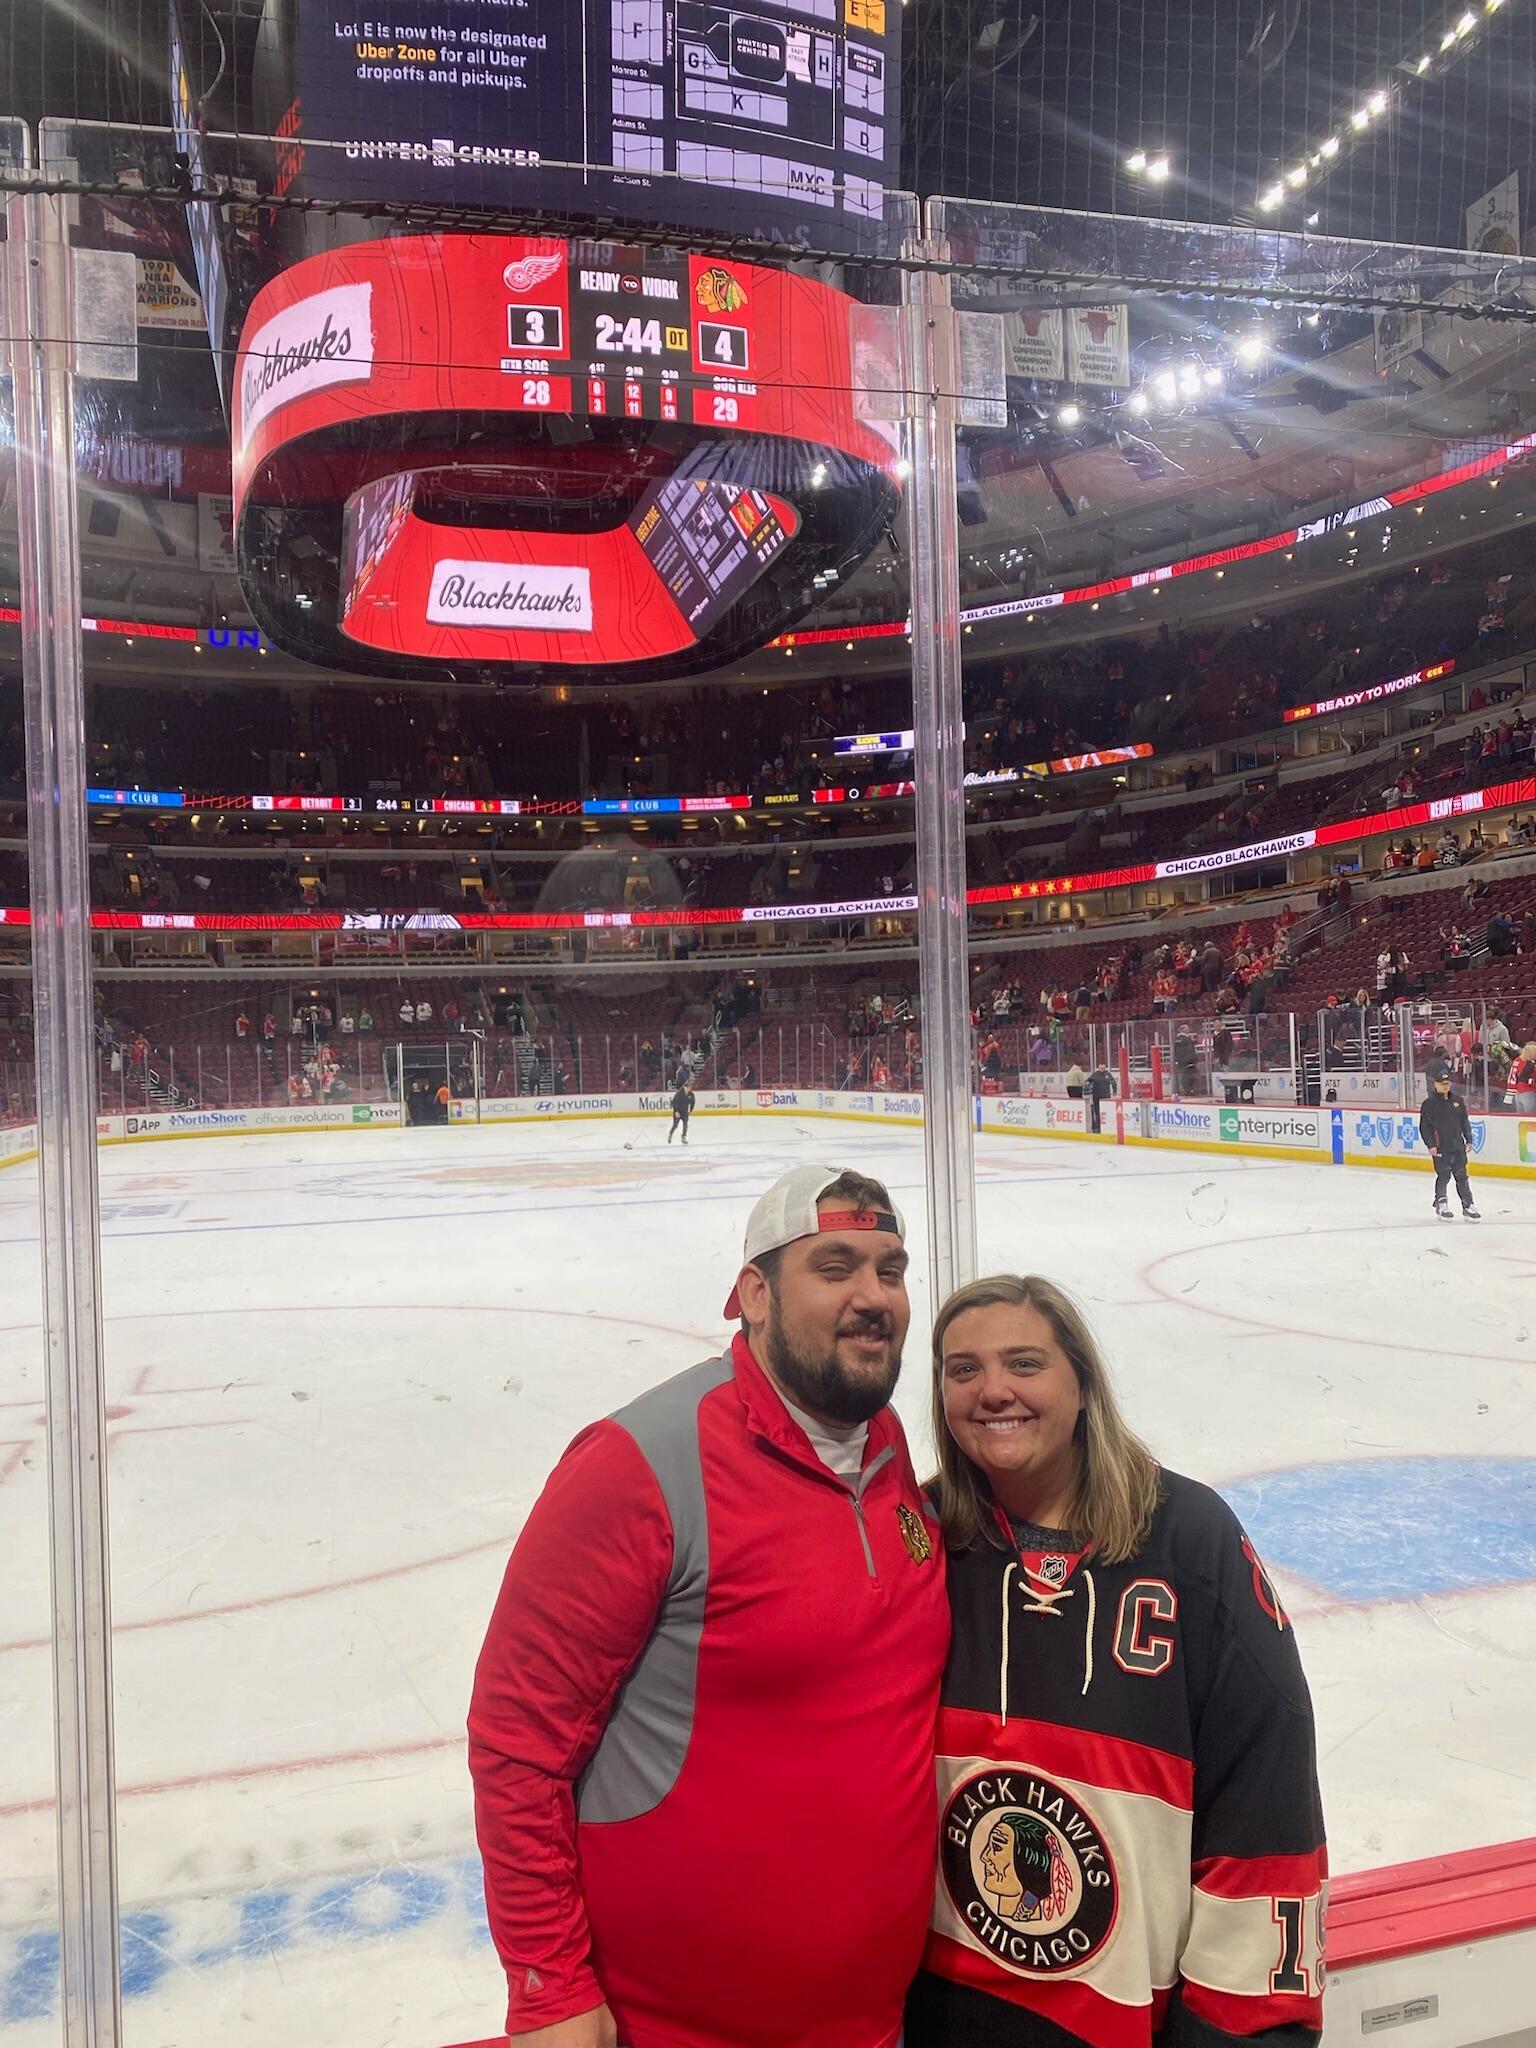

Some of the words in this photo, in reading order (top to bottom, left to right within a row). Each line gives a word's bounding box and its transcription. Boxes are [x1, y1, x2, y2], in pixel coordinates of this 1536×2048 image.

[334, 22, 358, 37] Lot
[363, 22, 374, 37] E
[376, 22, 390, 38] is
[394, 26, 428, 39] now
[429, 25, 457, 41] the
[460, 27, 548, 50] designated
[632, 22, 643, 39] F
[736, 37, 768, 49] UNITED
[736, 45, 768, 57] CENTER
[356, 43, 394, 60] Uber
[397, 45, 438, 61] Zone
[439, 47, 463, 63] for
[466, 49, 486, 65] all
[489, 51, 528, 68] Uber
[687, 52, 700, 69] G
[818, 54, 830, 73] H
[356, 64, 425, 83] dropoffs
[428, 68, 458, 84] and
[460, 70, 528, 90] pickups.
[611, 64, 639, 77] Monroe
[732, 94, 744, 111] K
[611, 117, 636, 130] Adams
[636, 121, 648, 131] St.
[860, 131, 870, 148] D
[344, 139, 429, 160] UNITED
[458, 144, 541, 168] CENTER
[141, 260, 171, 272] 1991
[144, 272, 171, 283] NBA
[580, 270, 619, 293] READY
[623, 280, 638, 289] TO
[642, 277, 679, 300] WORK
[1007, 280, 1053, 294] CHICAGO
[136, 294, 197, 308] AMPIONS
[525, 310, 545, 344] 3
[594, 313, 663, 356] 2:44
[669, 330, 685, 347] OT
[713, 329, 734, 363] 4
[524, 358, 549, 376] SOG
[522, 379, 551, 406] 28
[626, 385, 640, 399] 12
[664, 388, 673, 402] 9
[712, 396, 739, 423] 29
[593, 398, 602, 412] 3
[628, 401, 640, 415] 11
[662, 402, 676, 419] 13
[439, 573, 582, 613] Blackhawks
[966, 597, 1054, 621] BLACKHAWKS
[1316, 692, 1366, 714] READY
[1366, 685, 1384, 701] TO
[1384, 671, 1423, 695] WORK
[963, 768, 1018, 787] Blackhawks
[131, 793, 159, 804] CLUB
[300, 797, 333, 810] DETROIT
[376, 799, 398, 811] 2:44
[421, 800, 429, 811] 4
[443, 800, 475, 812] CHICAGO
[633, 801, 660, 811] CLUB
[1430, 797, 1453, 818] READY
[1461, 790, 1485, 812] WORK
[1164, 854, 1224, 875] CHICAGO
[1224, 836, 1306, 864] BLACKHAWKS
[753, 906, 817, 919] CHICAGO
[819, 898, 915, 915] BLACKHAWKS
[1256, 1078, 1272, 1087] AT&T
[1325, 1079, 1341, 1088] AT&T
[1362, 1079, 1381, 1089] AT&T
[557, 1098, 613, 1111] HYUNDAI
[638, 1096, 674, 1111] Model
[757, 1095, 772, 1107] us
[773, 1091, 799, 1106] bank
[359, 1107, 400, 1119] enter
[1006, 1100, 1032, 1117] Sports
[1056, 1109, 1083, 1124] BELLE
[1154, 1106, 1211, 1128] rthShore
[176, 1112, 247, 1127] NorthShore
[255, 1112, 286, 1126] office
[289, 1110, 345, 1123] revolution
[1003, 1115, 1026, 1126] CHICAGO
[1223, 1116, 1317, 1139] enterprise
[1044, 1560, 1064, 1579] NHL
[1112, 1577, 1178, 1677] C
[946, 1776, 1018, 1850] BLACK
[1026, 1780, 1112, 1890] HAWKS
[965, 1900, 1091, 1967] CHICAGO
[1268, 1894, 1327, 1998] 1
